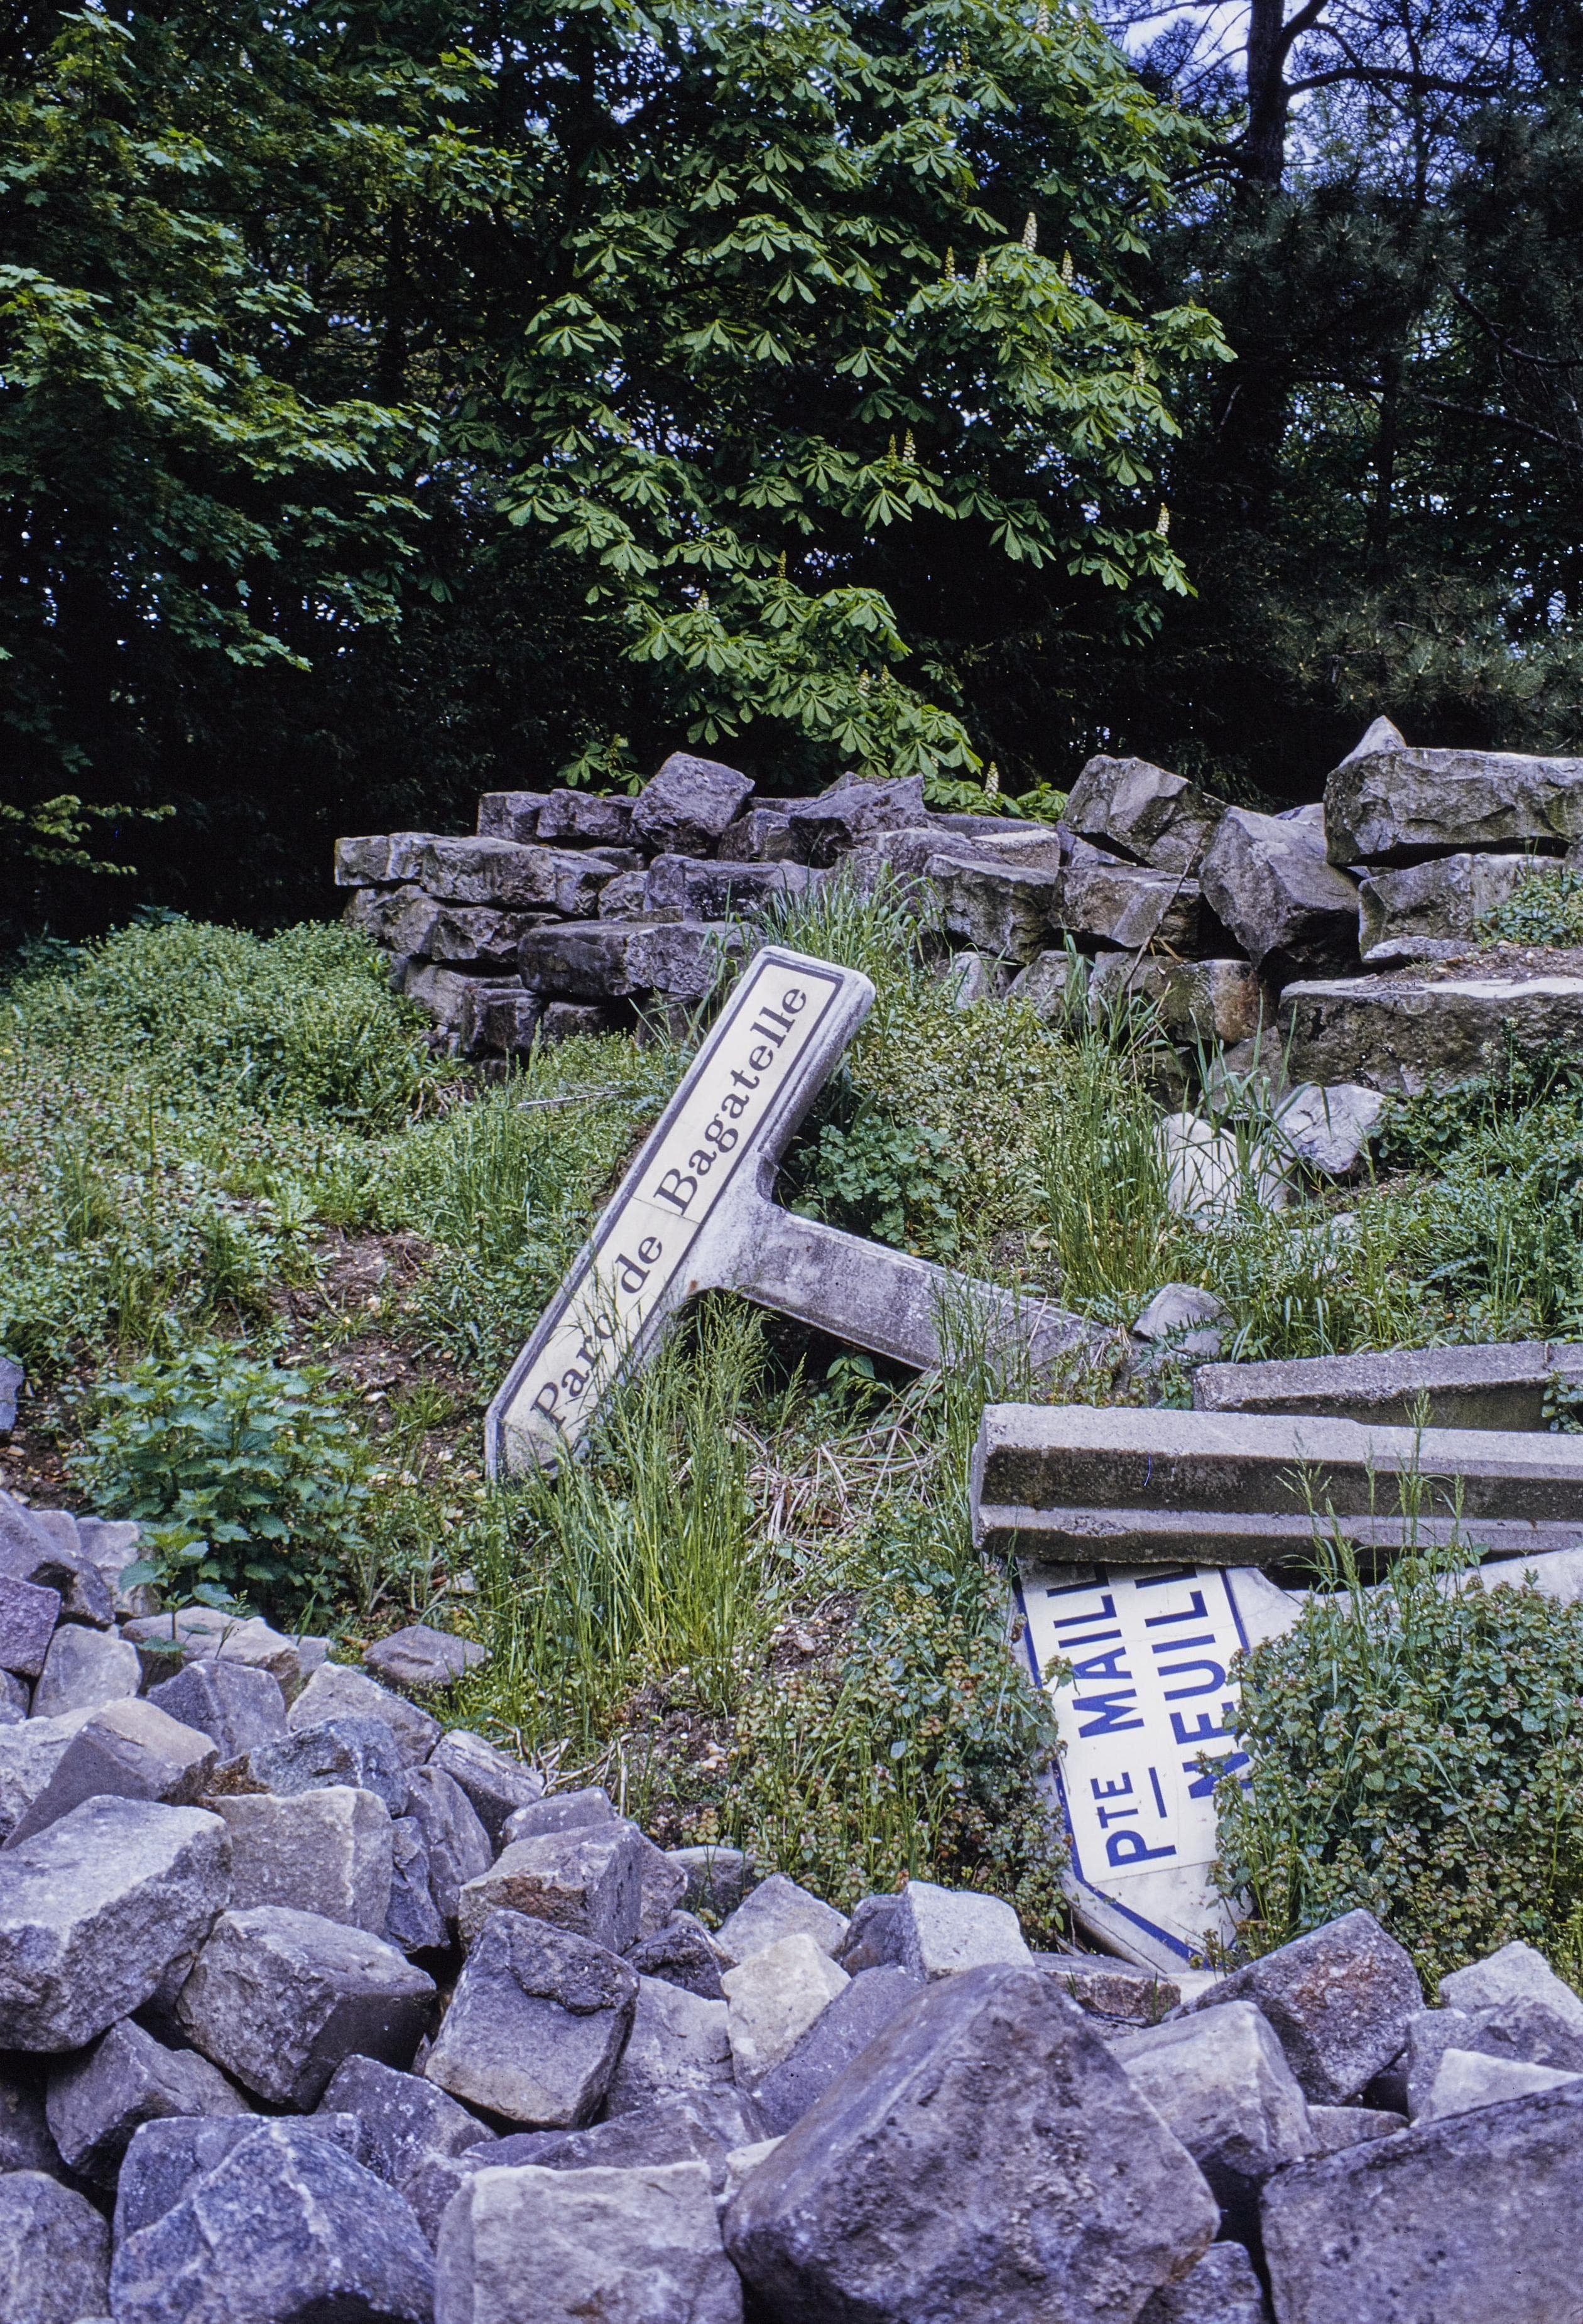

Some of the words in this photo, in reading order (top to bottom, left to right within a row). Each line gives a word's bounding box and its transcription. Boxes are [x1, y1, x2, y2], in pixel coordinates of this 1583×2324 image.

[530, 1313, 615, 1432] Parc
[616, 1235, 663, 1294] de
[653, 987, 807, 1215] Bagatelle
[1045, 1563, 1145, 1739] MAILL
[1091, 1772, 1177, 1868] PTE
